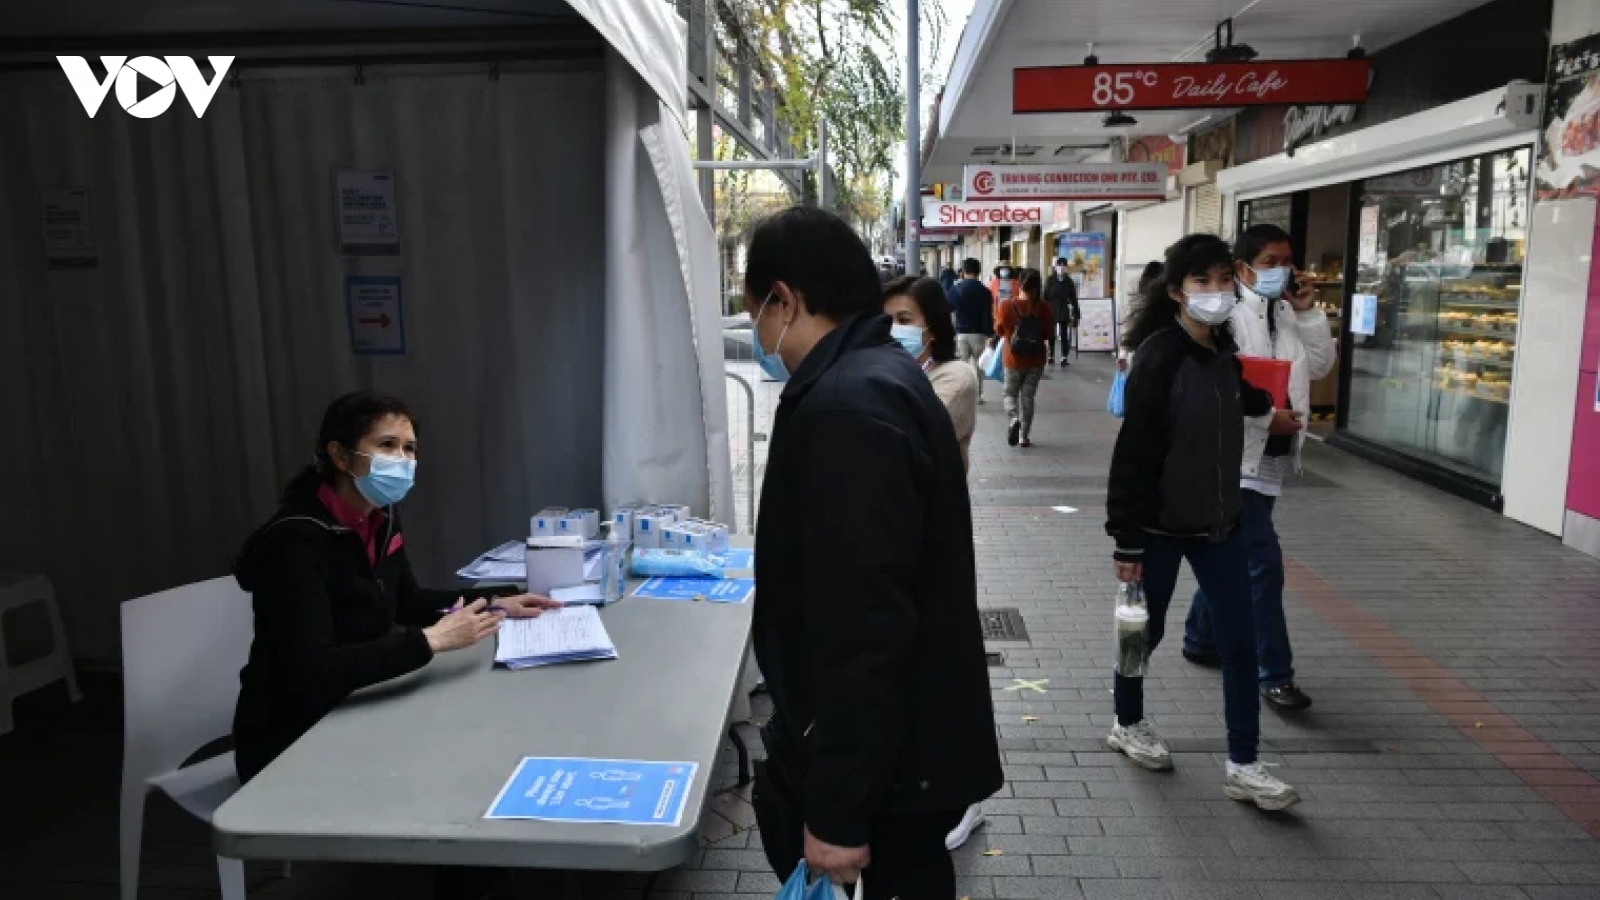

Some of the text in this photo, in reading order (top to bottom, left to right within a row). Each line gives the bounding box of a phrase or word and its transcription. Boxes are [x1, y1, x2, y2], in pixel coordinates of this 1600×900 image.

[1172, 72, 1233, 101] Daily
[1235, 70, 1289, 98] Cafe
[1002, 173, 1041, 183] TRAINING
[1044, 173, 1100, 184] CONNECTION
[1101, 173, 1118, 183] ONE
[939, 205, 1041, 223] Sharetea
